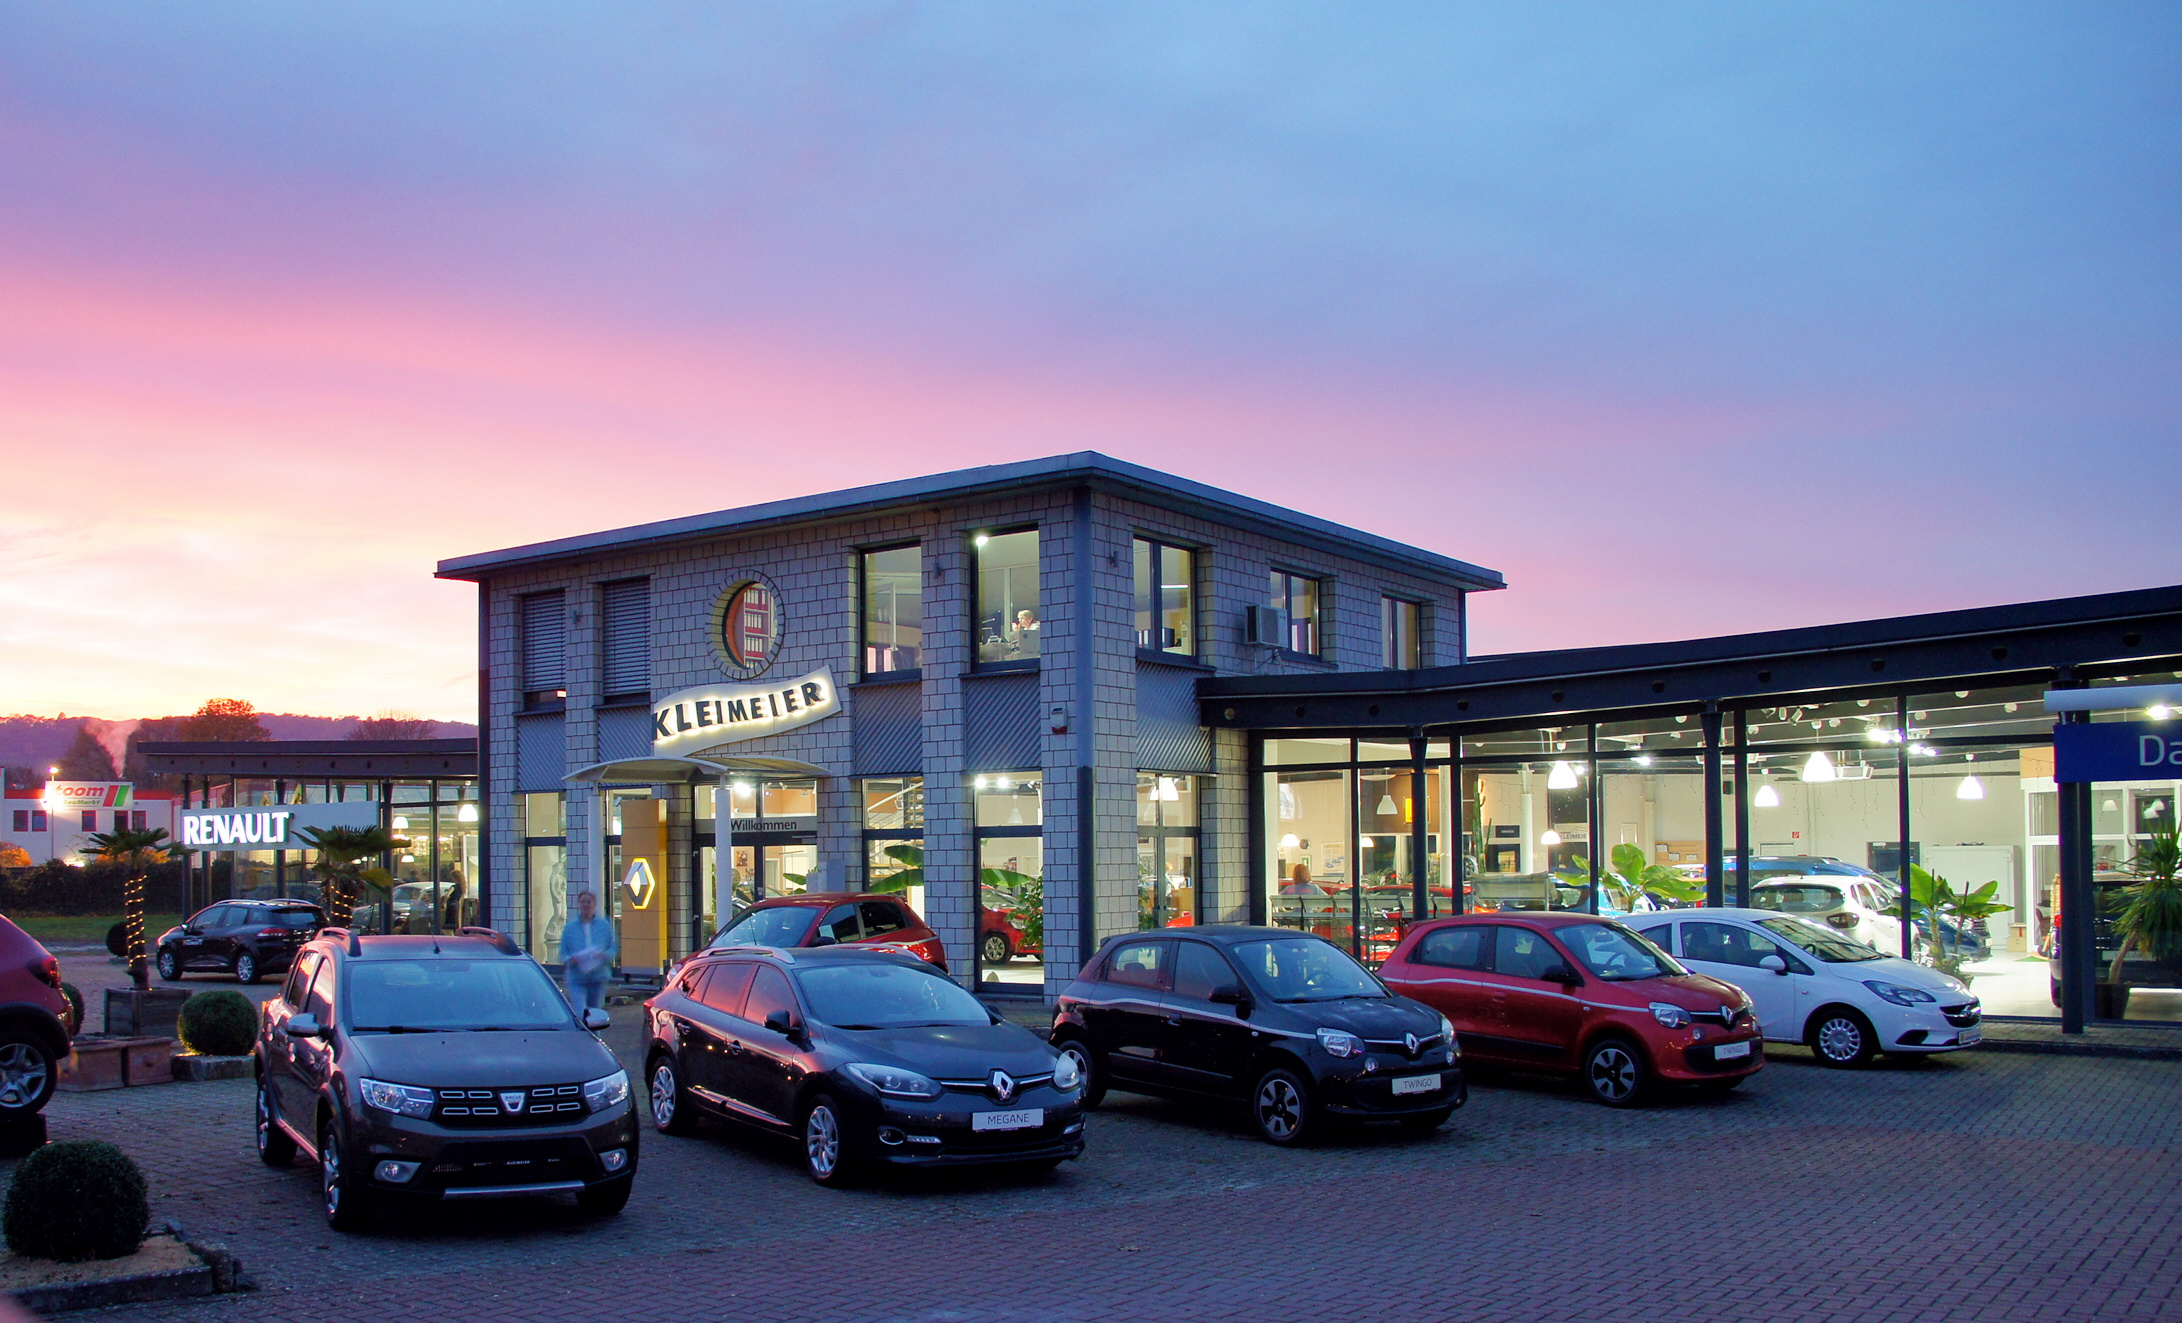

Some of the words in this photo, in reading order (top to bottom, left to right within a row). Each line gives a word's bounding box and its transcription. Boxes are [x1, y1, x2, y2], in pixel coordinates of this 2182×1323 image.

[651, 682, 823, 740] KLEIMEIER
[2139, 734, 2182, 766] Da
[55, 784, 105, 797] toom
[183, 811, 290, 845] RENAULT
[730, 819, 797, 831] Willkommen
[1403, 1078, 1433, 1089] TWINGO
[987, 1113, 1030, 1125] MEGANE
